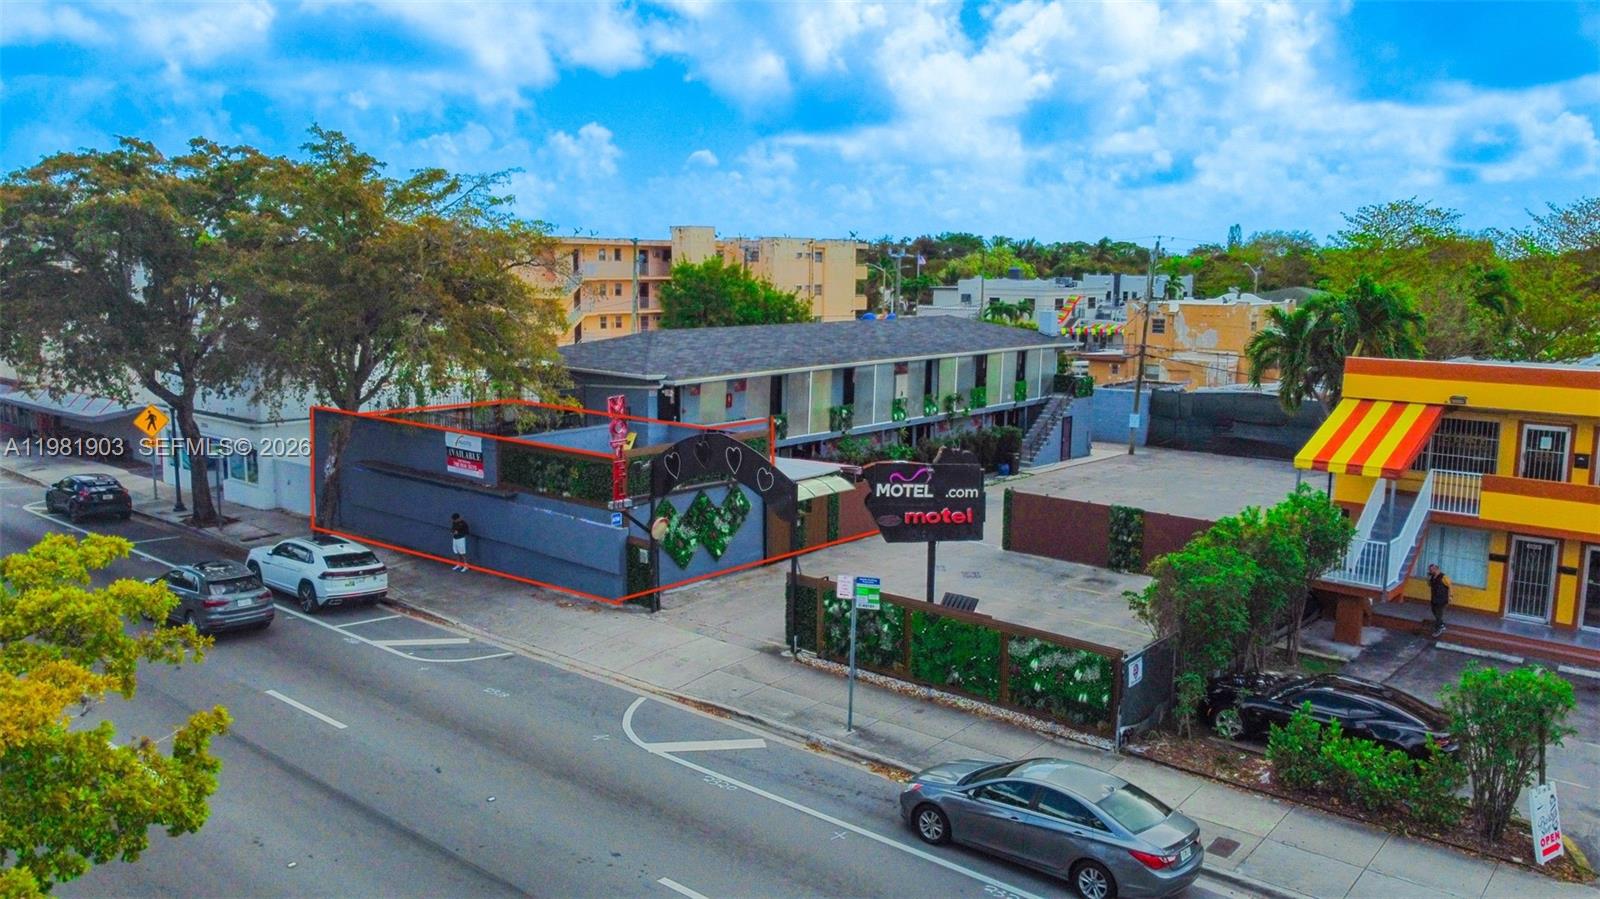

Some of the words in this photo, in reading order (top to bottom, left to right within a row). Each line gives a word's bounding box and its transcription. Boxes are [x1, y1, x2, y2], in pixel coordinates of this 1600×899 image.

[448, 448, 481, 461] AVAILABLE
[876, 483, 934, 498] MOTEL
[945, 488, 979, 498] .com
[904, 507, 974, 525] motel
[1540, 831, 1561, 848] OPEN
